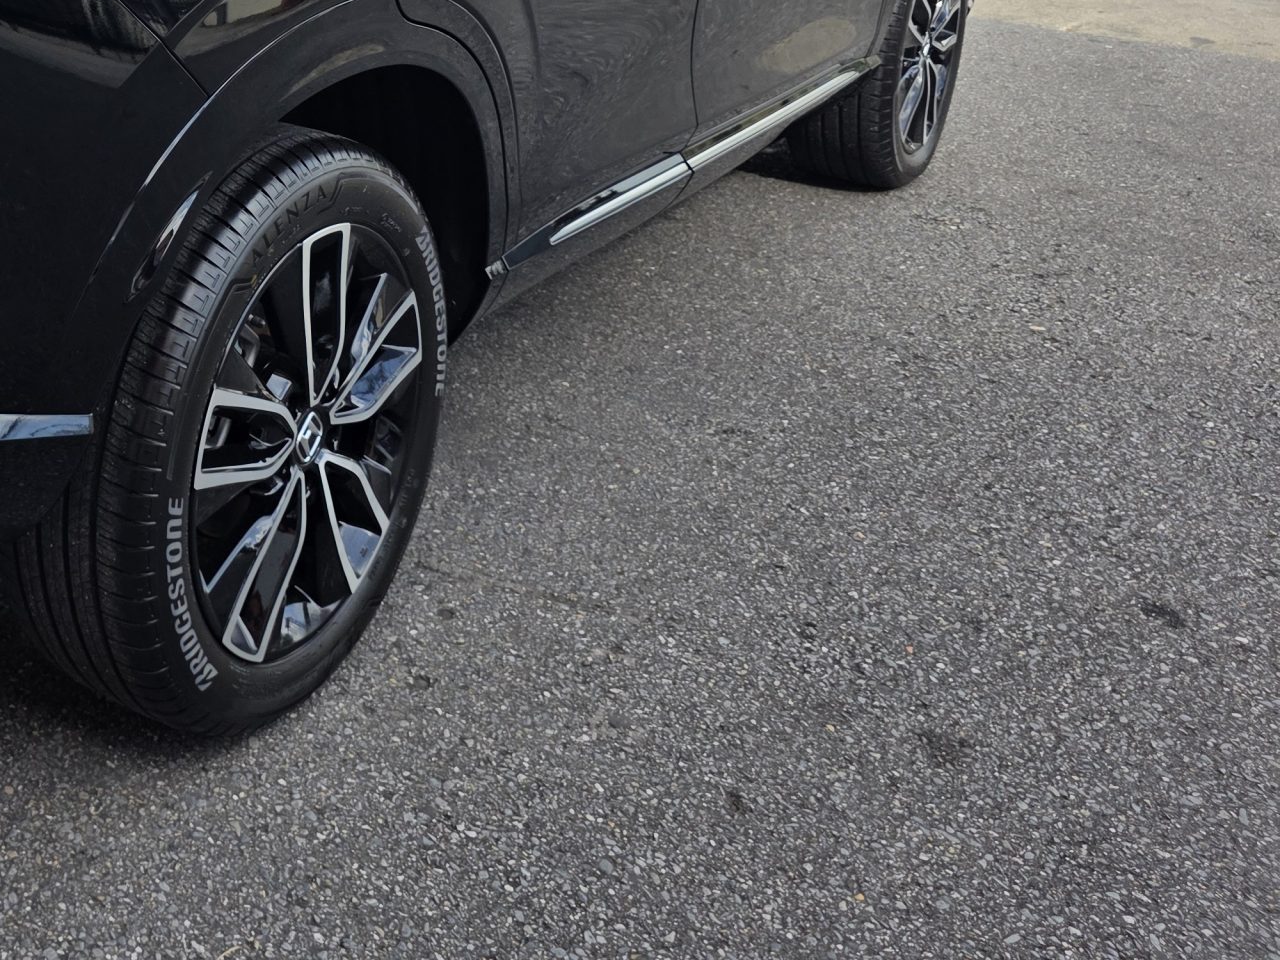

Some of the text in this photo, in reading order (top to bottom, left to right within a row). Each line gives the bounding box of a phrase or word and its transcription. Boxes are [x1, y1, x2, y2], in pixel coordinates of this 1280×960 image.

[251, 185, 328, 264] ALENZA
[414, 226, 451, 398] BRIDGESTONE
[161, 496, 220, 692] BRIDGESTONE
